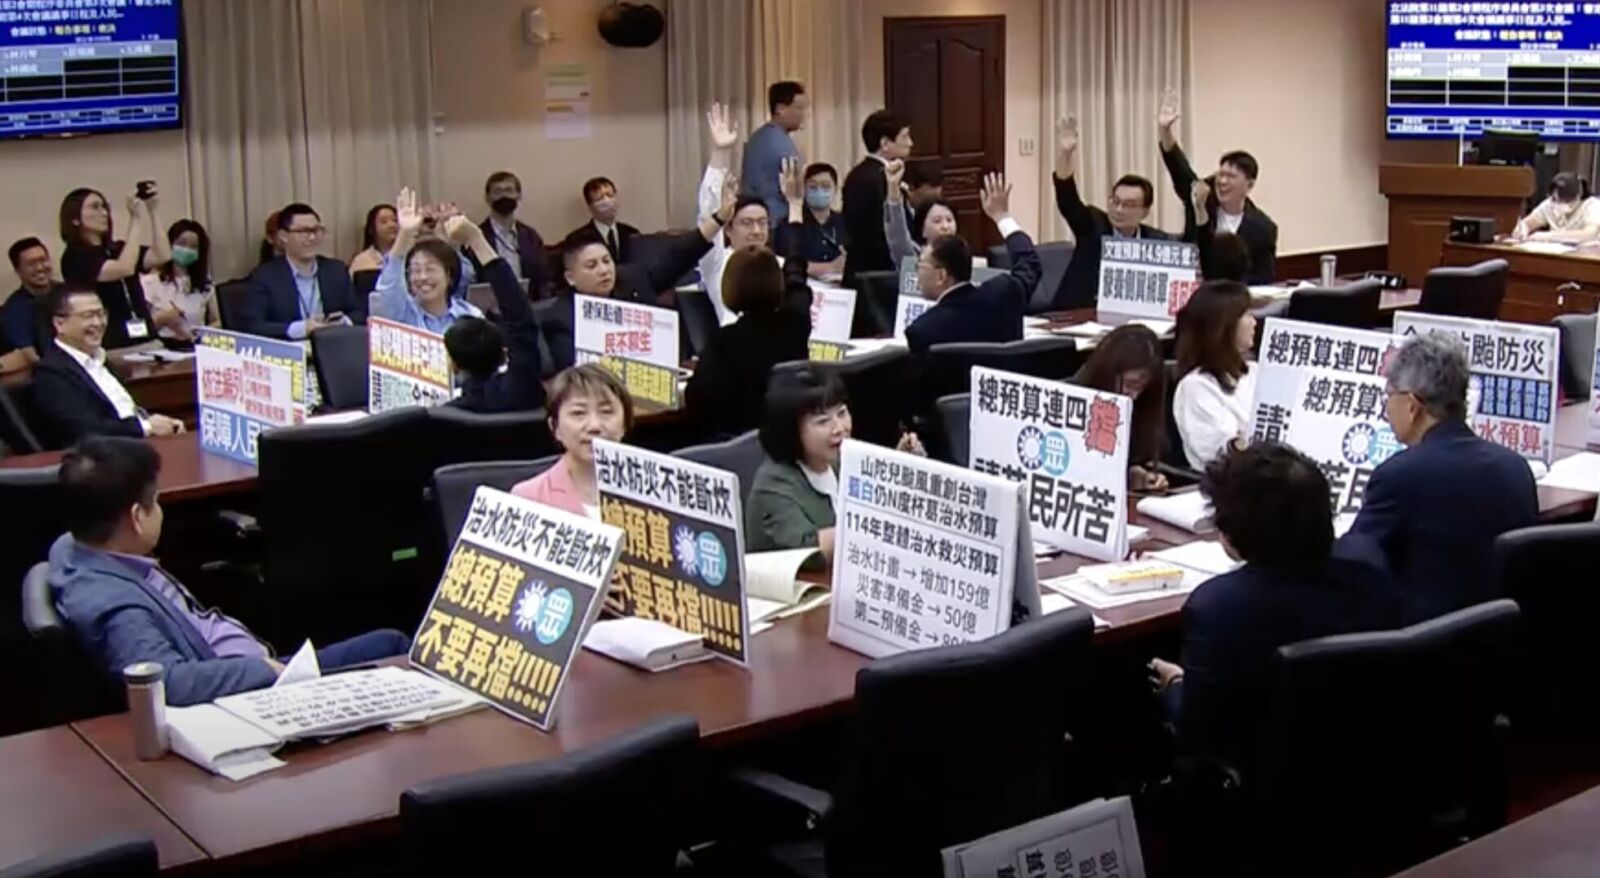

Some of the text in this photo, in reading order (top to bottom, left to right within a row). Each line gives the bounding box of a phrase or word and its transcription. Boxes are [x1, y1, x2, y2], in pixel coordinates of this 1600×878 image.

[605, 330, 652, 353] 民不聊生
[1302, 375, 1389, 423] 總預算
[202, 408, 262, 459] 保障人民
[1472, 418, 1541, 454] 水預算
[596, 448, 733, 519] 治水防災不能斷炊
[848, 475, 998, 540] 藍白仍N度杯葛治水預算
[861, 455, 987, 510] 山陀兒颱風重創台灣
[467, 496, 611, 578] 治水防災不能斷炊
[847, 512, 998, 577] 114年整體治水救災預算
[441, 546, 525, 624] 總預算
[857, 573, 977, 635] 災害準備金 50億
[920, 566, 990, 610] 增加159億
[854, 599, 922, 644] 第二預備金
[419, 609, 561, 714] 不要再擋!!!!!
